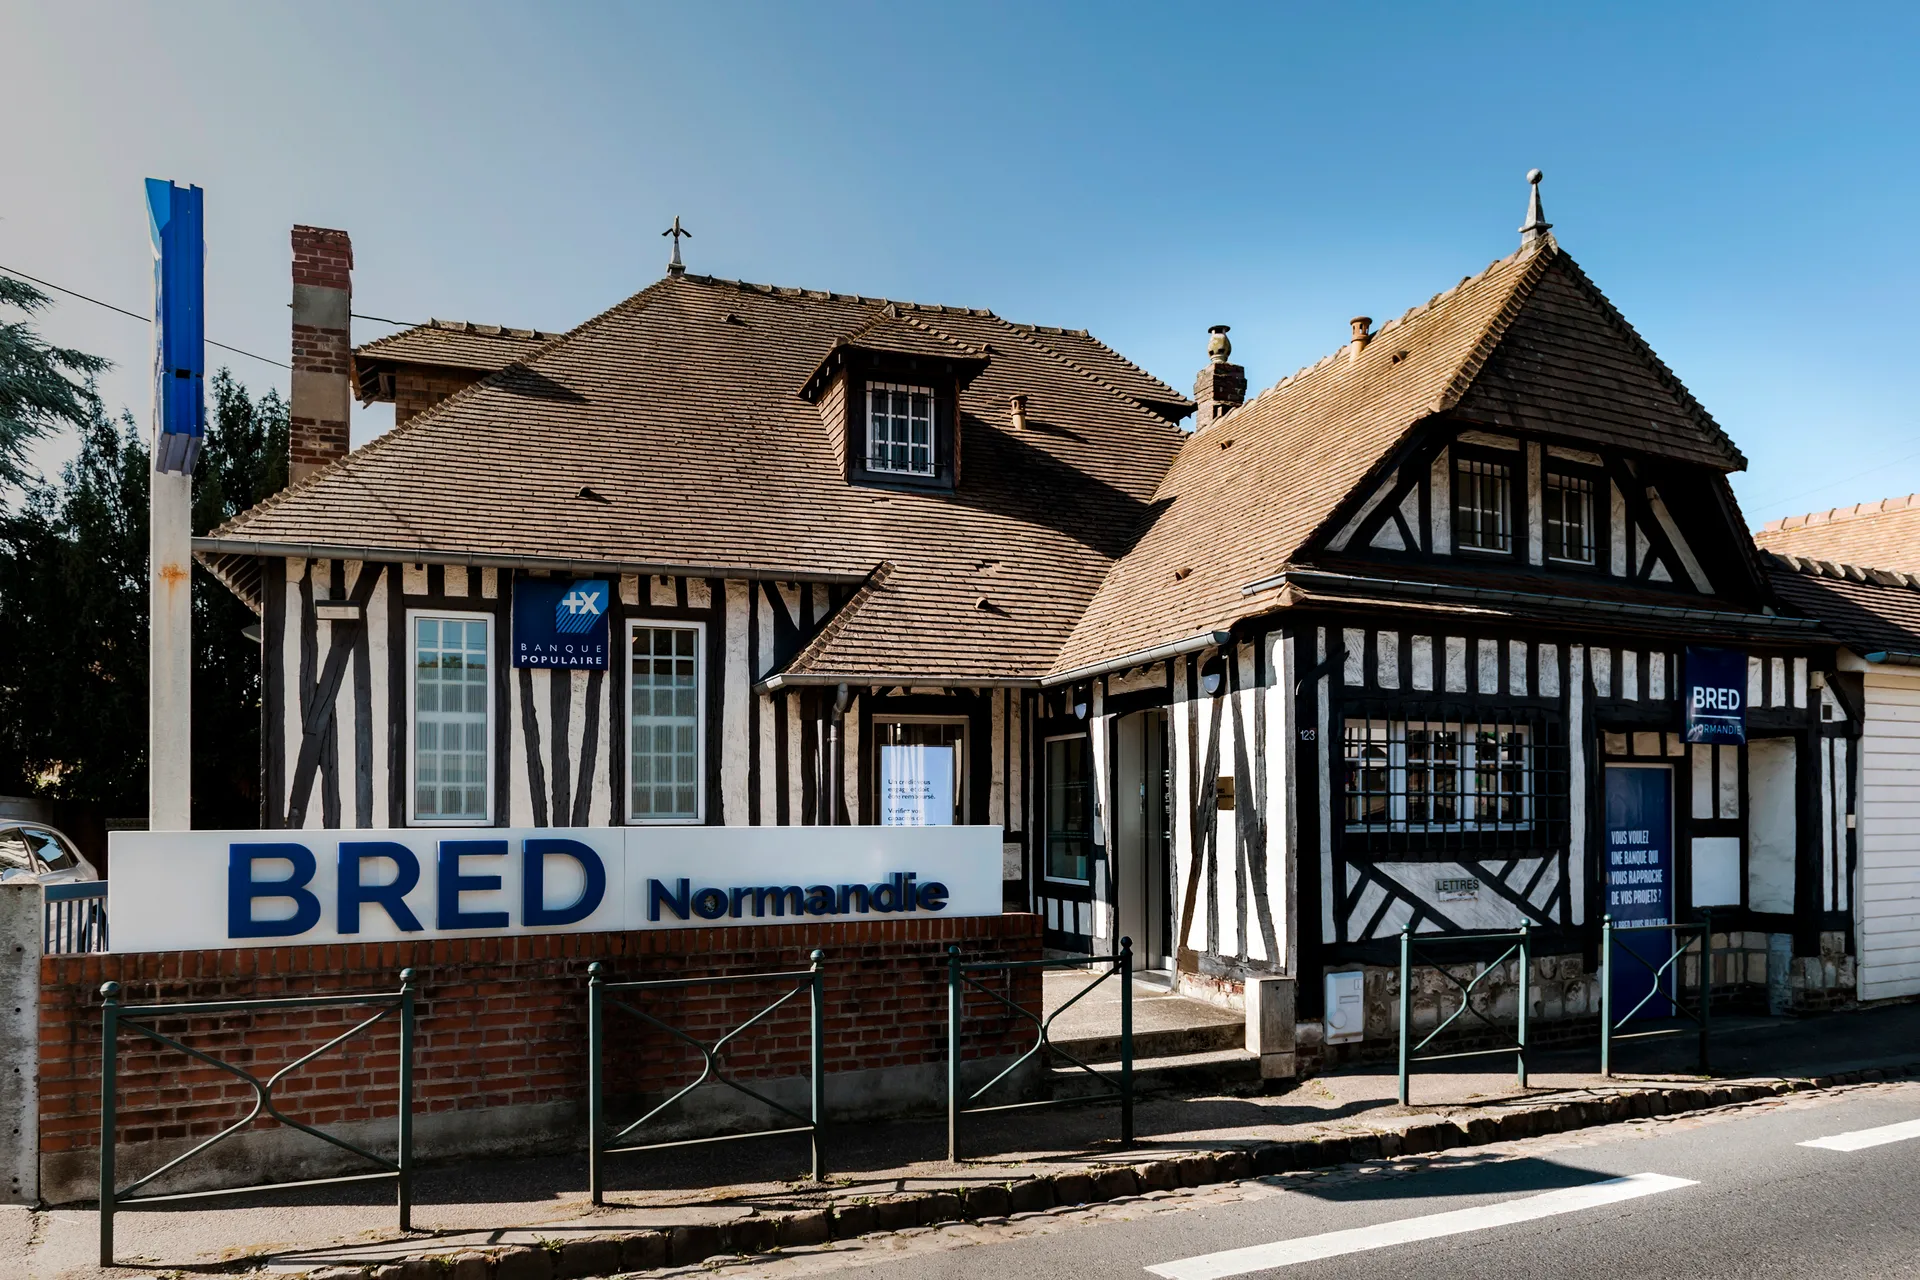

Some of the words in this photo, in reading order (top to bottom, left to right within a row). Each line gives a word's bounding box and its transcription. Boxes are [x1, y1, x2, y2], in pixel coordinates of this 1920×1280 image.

[520, 642, 602, 654] BANQUE
[521, 655, 602, 665] POPULAIRE
[1693, 686, 1741, 711] BRED
[1300, 729, 1316, 741] 123
[1691, 723, 1742, 735] NORMANDIE
[1611, 830, 1628, 845] VOUS
[1628, 830, 1650, 845] VOULEZ
[1611, 851, 1623, 865] UNE
[1624, 850, 1647, 866] BANQUE
[1648, 850, 1659, 865] QUI
[1611, 871, 1628, 885] VOUS
[1628, 869, 1663, 885] RAPPROCHE
[228, 838, 607, 939] BRED
[646, 871, 950, 922] Normandie
[1437, 879, 1479, 891] LETTRES
[1611, 891, 1620, 906] DE
[1620, 890, 1633, 905] VOS
[1634, 889, 1658, 904] PROJETS
